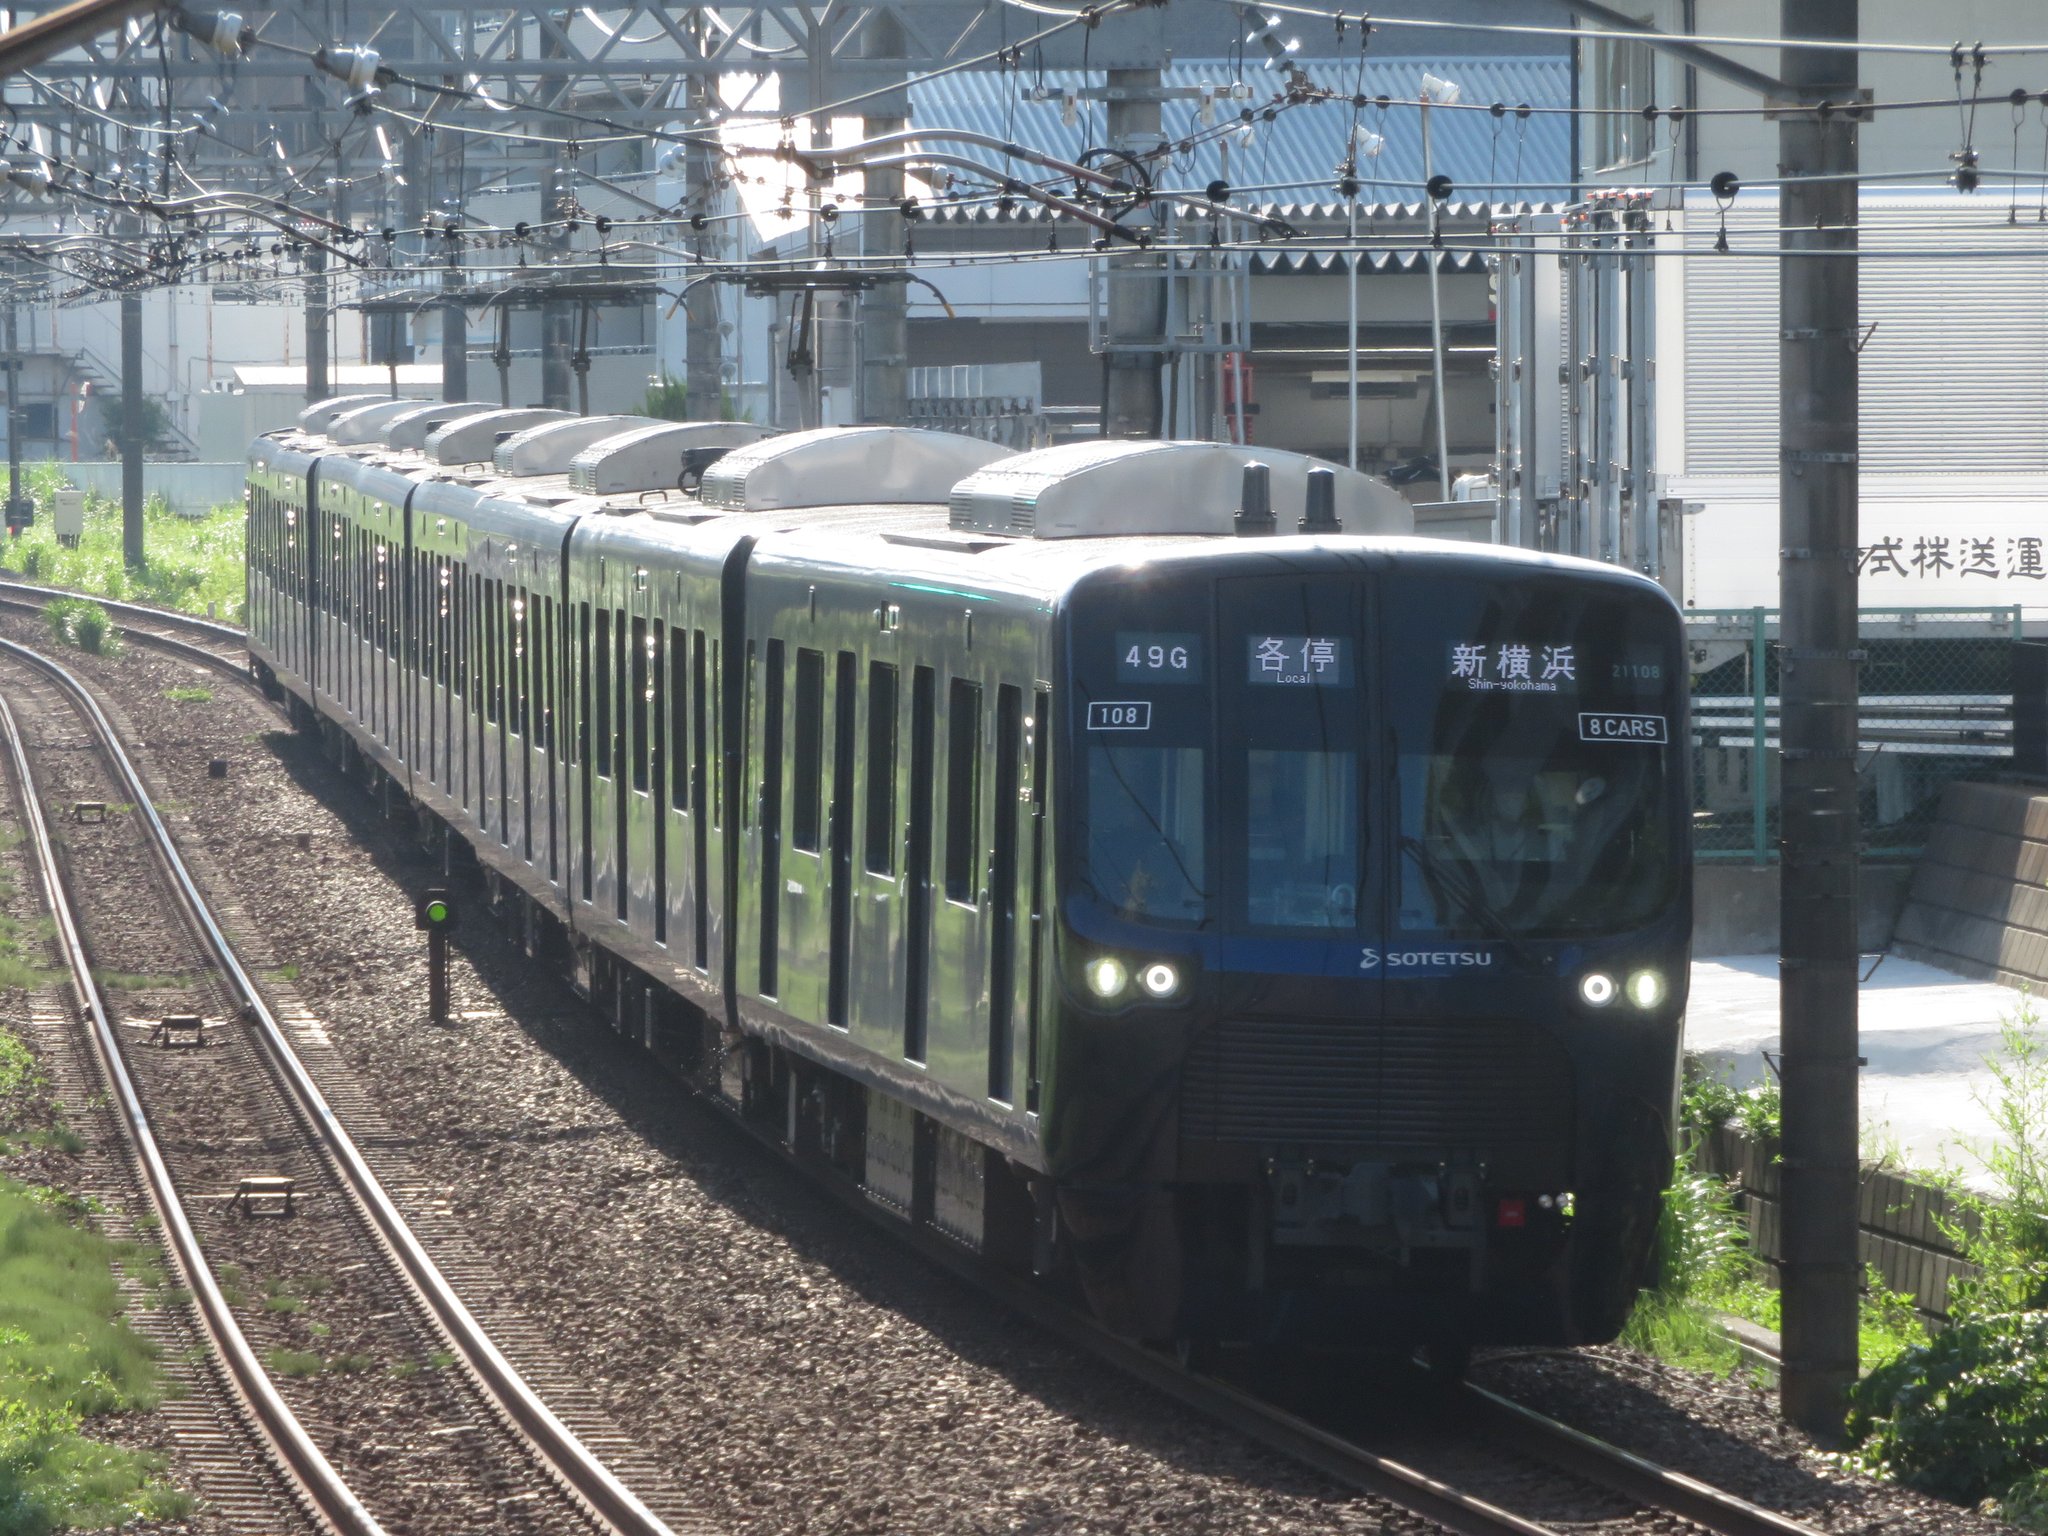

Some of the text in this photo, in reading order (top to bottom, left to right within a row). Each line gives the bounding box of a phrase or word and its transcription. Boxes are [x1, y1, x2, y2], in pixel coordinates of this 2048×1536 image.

[1125, 645, 1187, 669] 49G
[1255, 636, 1335, 673] 各停
[1451, 643, 1576, 681] 新横浜
[1276, 671, 1311, 684] Local
[1467, 678, 1557, 691] Shin-yokohama
[1101, 706, 1138, 725] 108
[1386, 951, 1492, 967] SOTETSU
